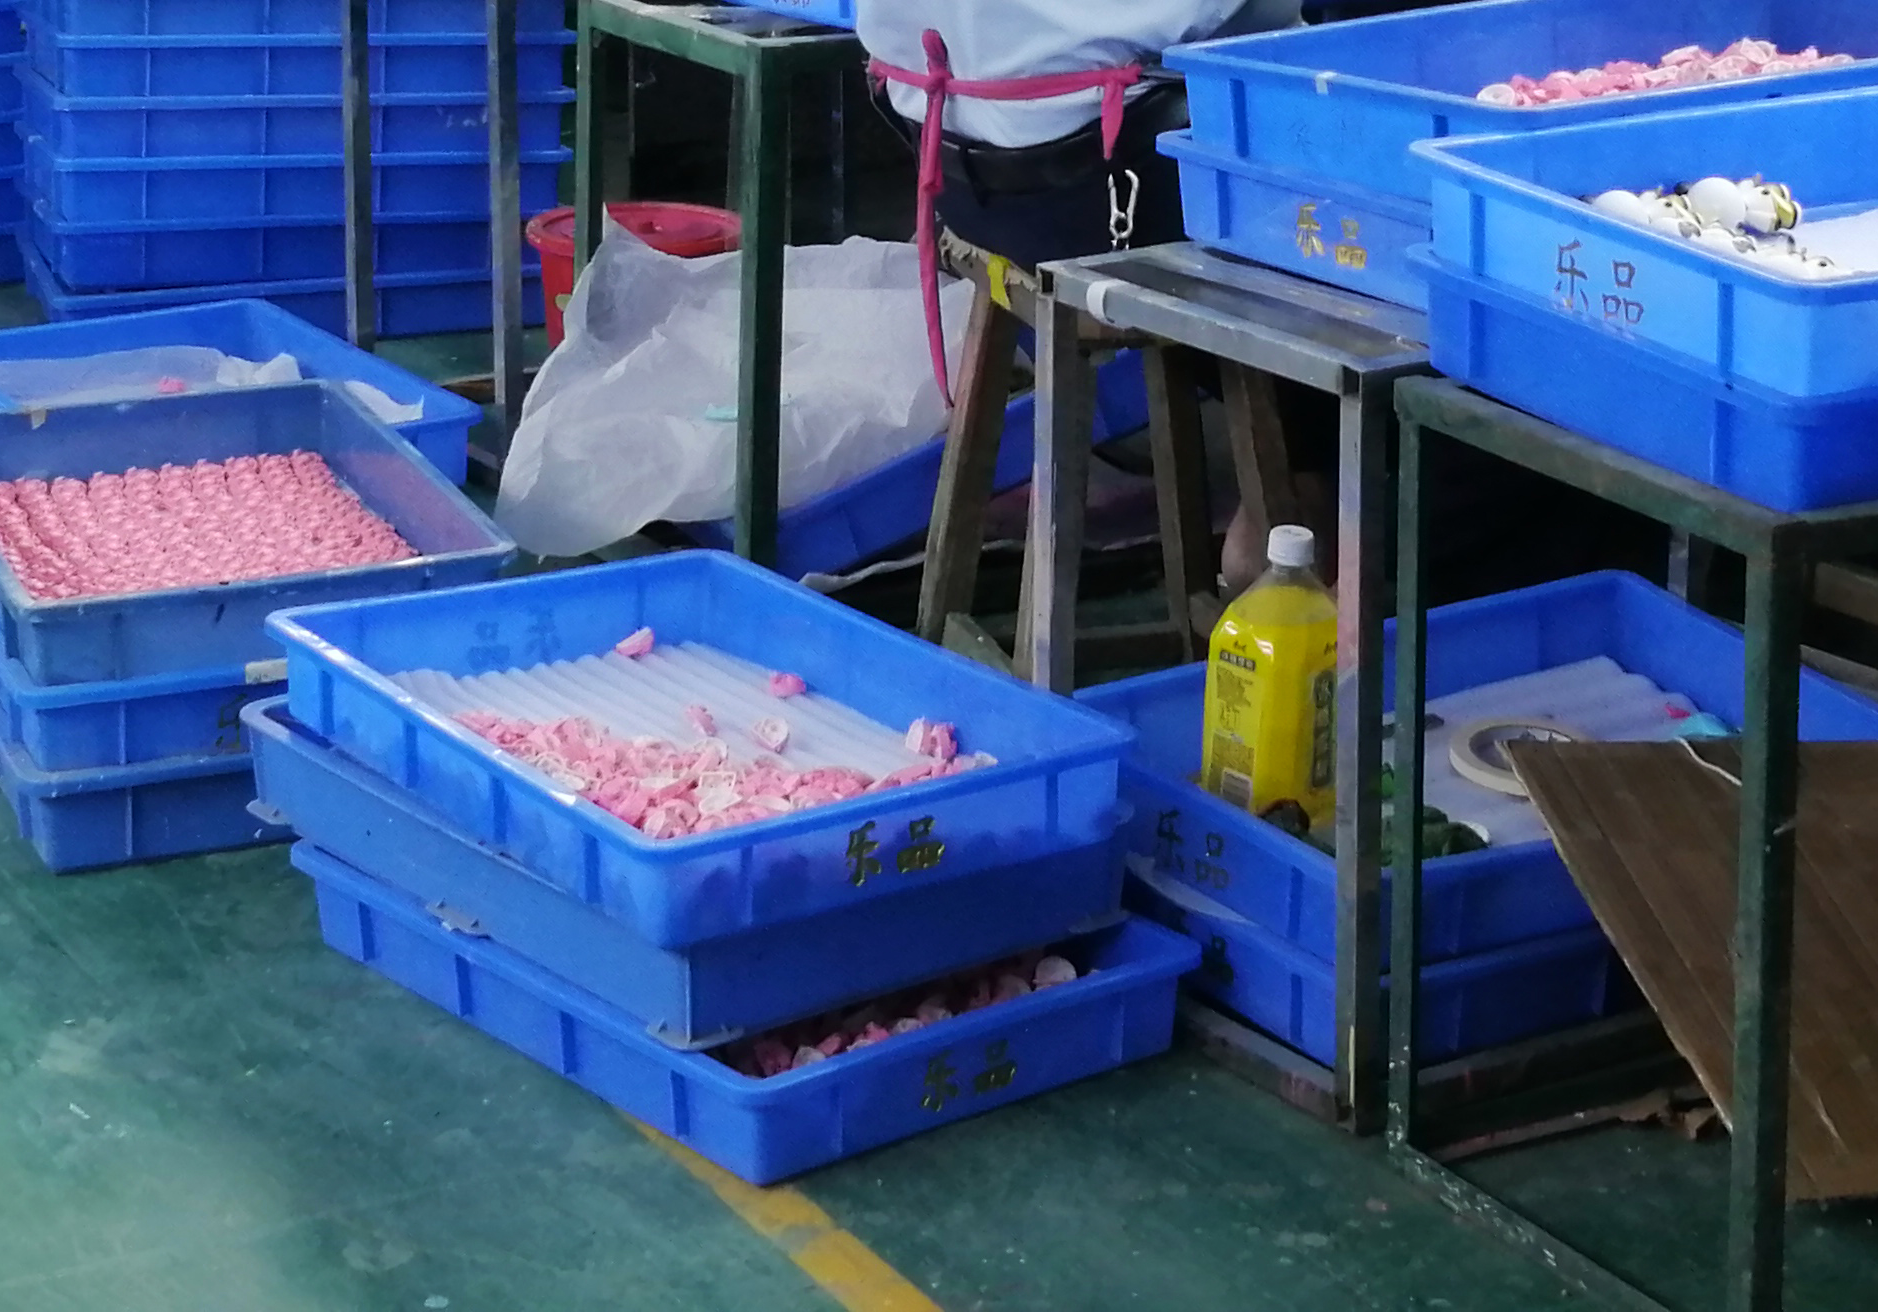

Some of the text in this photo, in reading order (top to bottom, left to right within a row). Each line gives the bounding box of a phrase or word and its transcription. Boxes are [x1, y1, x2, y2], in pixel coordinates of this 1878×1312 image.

[1295, 203, 1368, 271] 乐品
[1553, 237, 1644, 325] 乐品
[845, 815, 946, 887] 乐品
[922, 1038, 1017, 1113] 乐品
